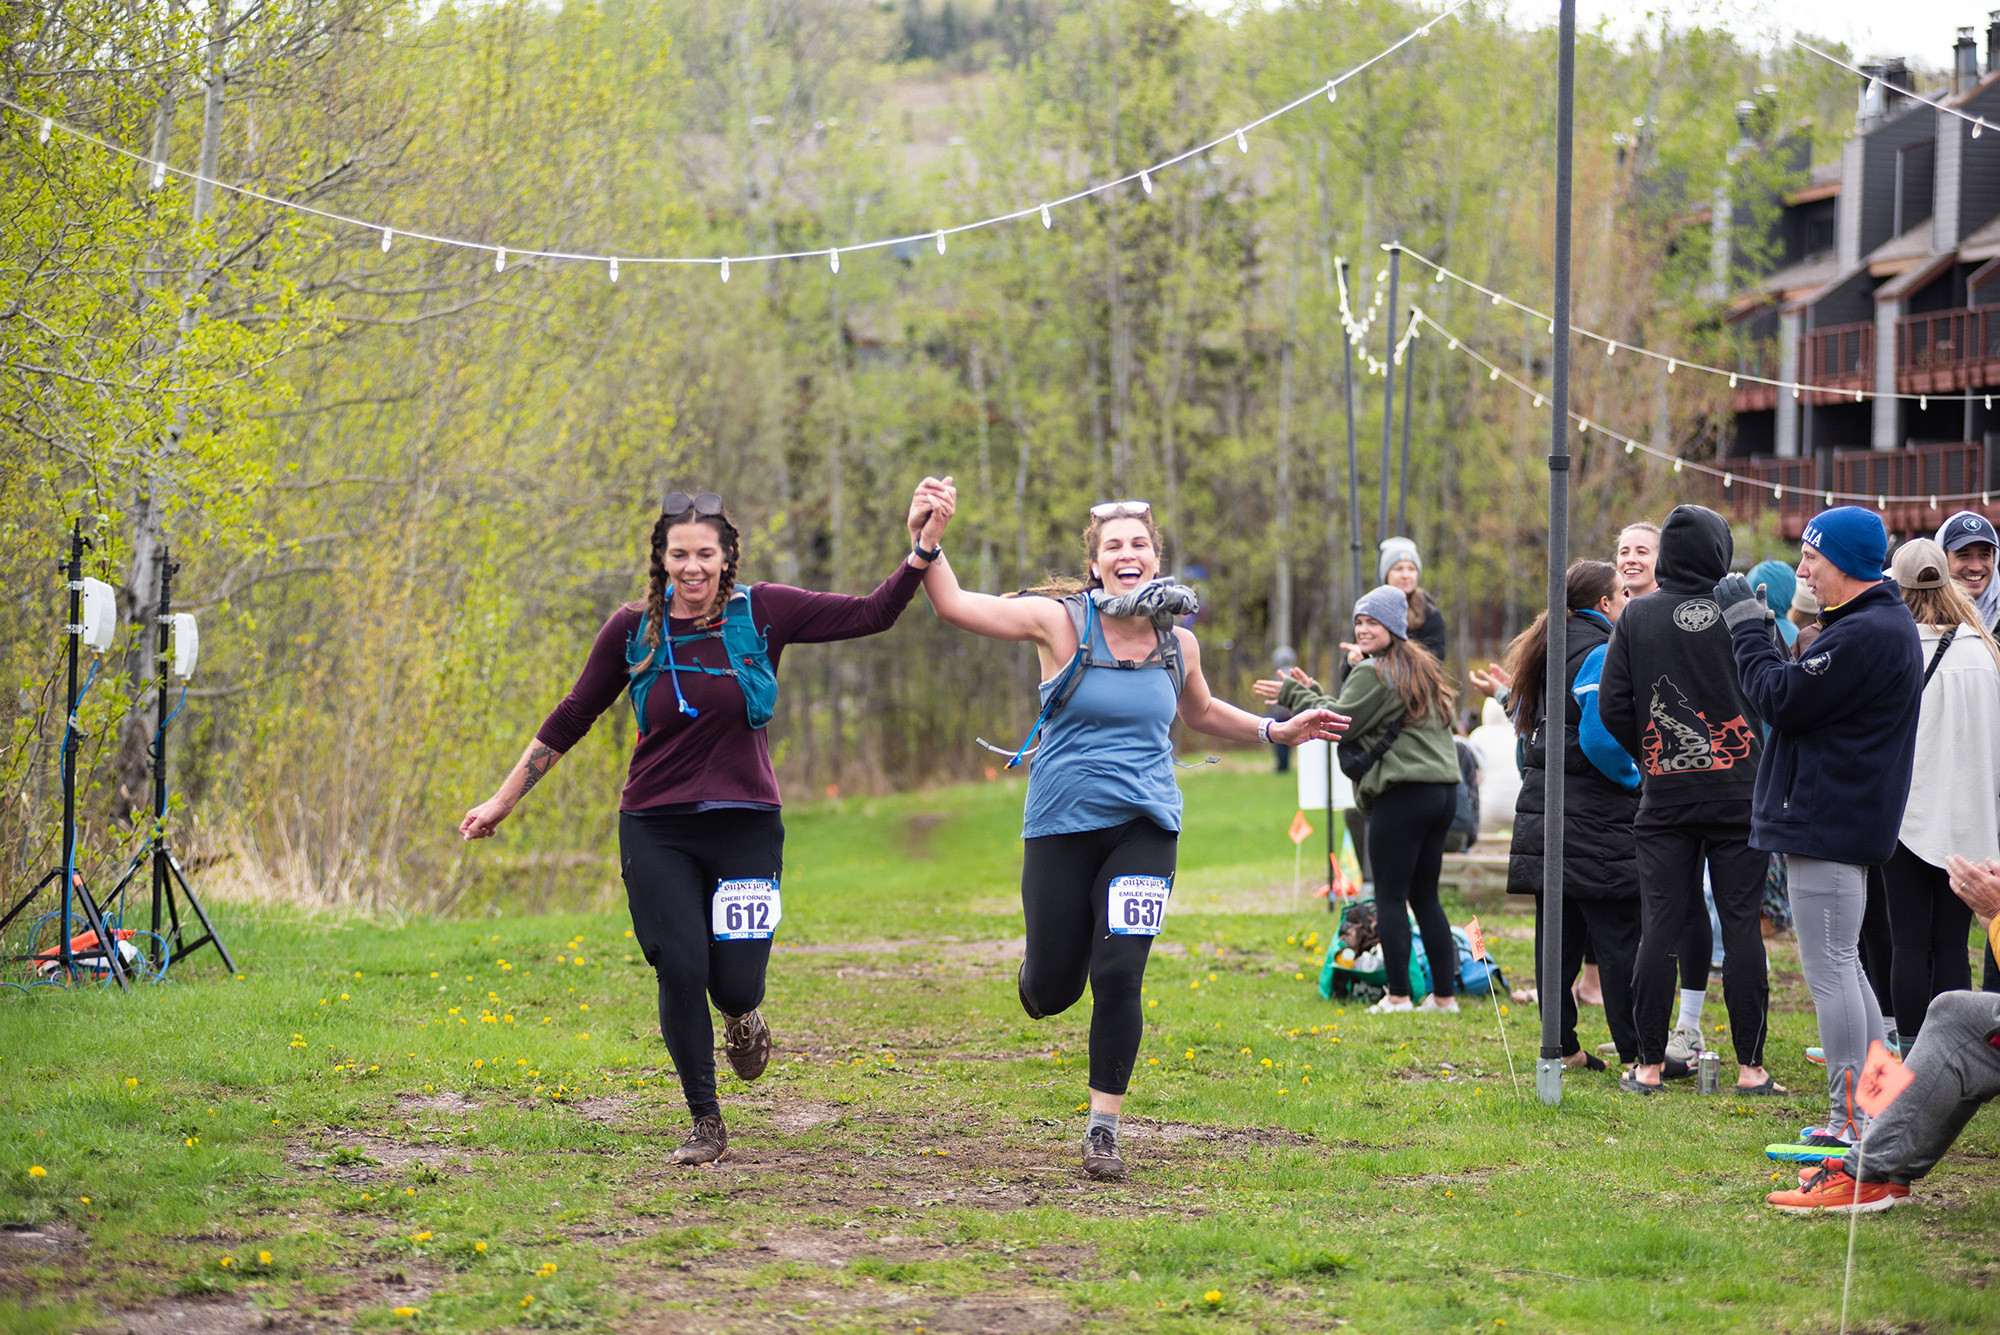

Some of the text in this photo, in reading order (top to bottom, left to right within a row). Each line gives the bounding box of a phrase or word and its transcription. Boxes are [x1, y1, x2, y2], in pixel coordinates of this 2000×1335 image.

[1659, 756, 1712, 772] 100
[726, 902, 770, 931] 612
[1124, 898, 1163, 928] 637
[729, 931, 749, 939] 25KM
